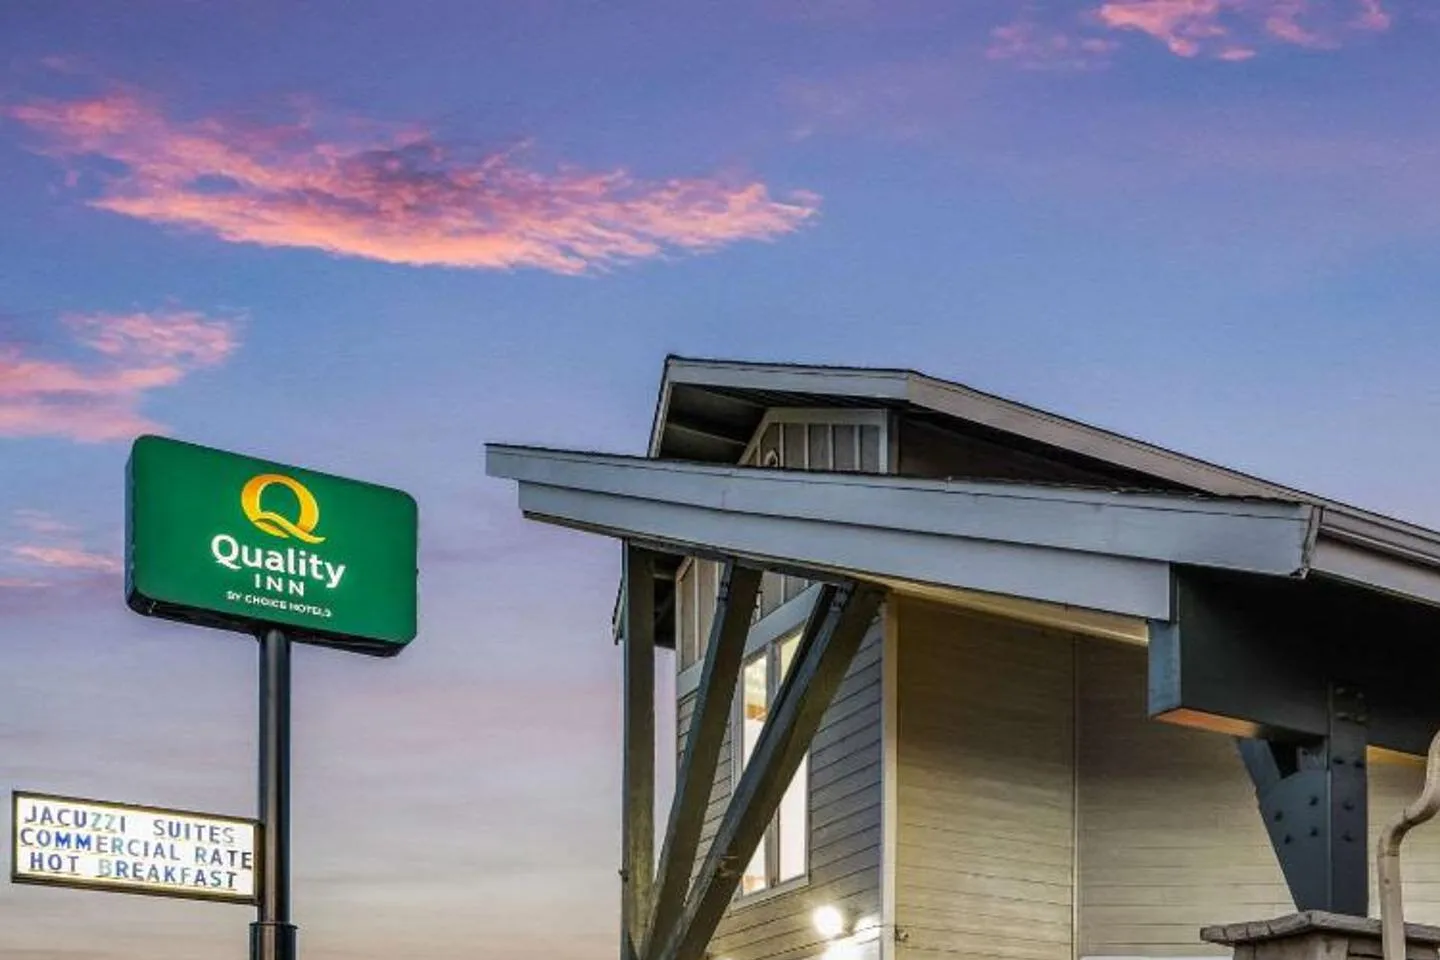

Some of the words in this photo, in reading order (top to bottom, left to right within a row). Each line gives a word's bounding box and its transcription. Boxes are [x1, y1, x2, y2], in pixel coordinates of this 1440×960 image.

[241, 473, 325, 544] Q
[211, 534, 345, 588] Quality
[245, 595, 286, 609] CHOICE
[255, 573, 304, 596] INN
[24, 806, 126, 833] JACUZZI
[153, 820, 235, 844] SUITES
[20, 828, 180, 860] COMMERCIAL
[195, 847, 252, 870] RATE
[30, 852, 79, 872] HOT
[98, 859, 237, 889] BREAKFAST
